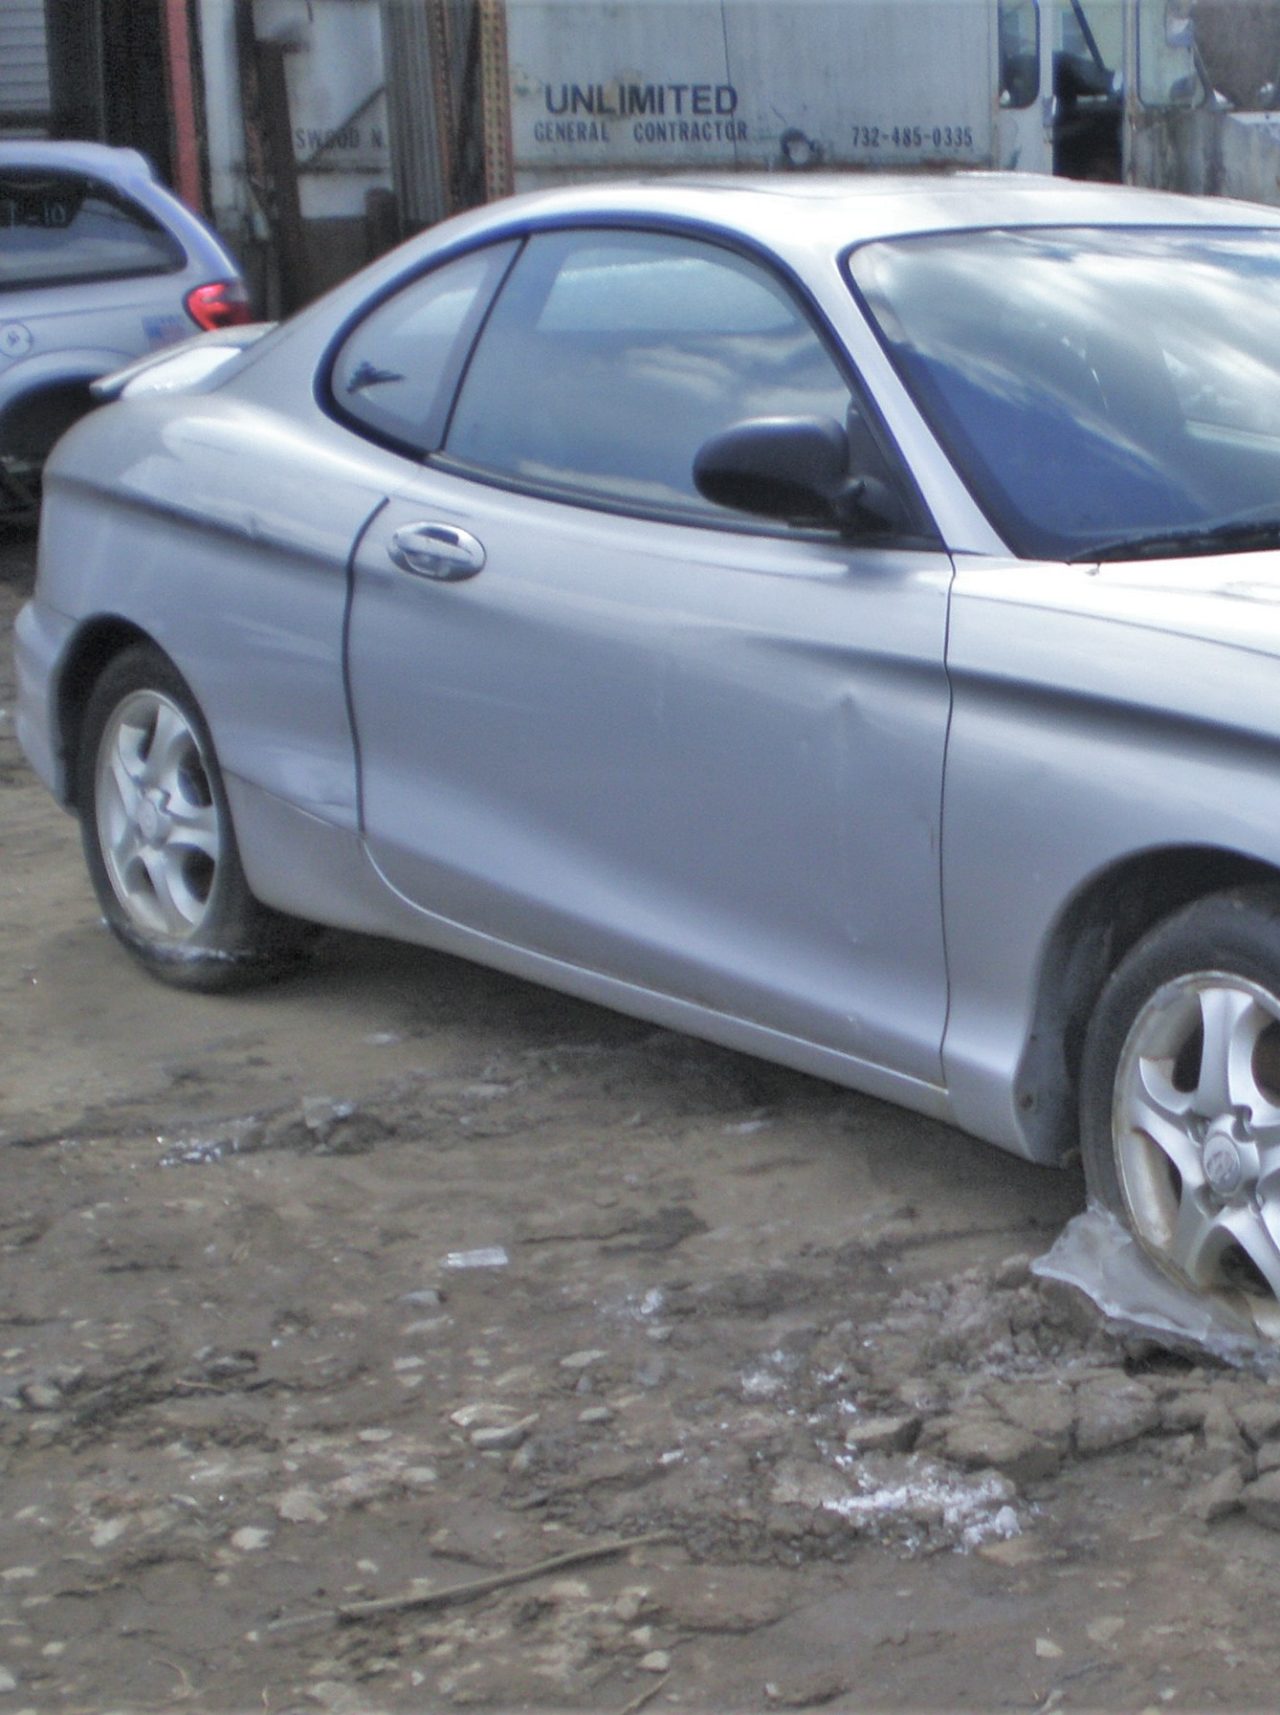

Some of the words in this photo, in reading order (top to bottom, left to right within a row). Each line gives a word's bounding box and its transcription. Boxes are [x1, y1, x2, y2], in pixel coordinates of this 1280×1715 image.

[544, 83, 738, 115] UNLIMITED
[533, 120, 610, 142] GENERAL
[633, 120, 748, 142] CONTRACTOR
[852, 126, 973, 147] 732-485-0335
